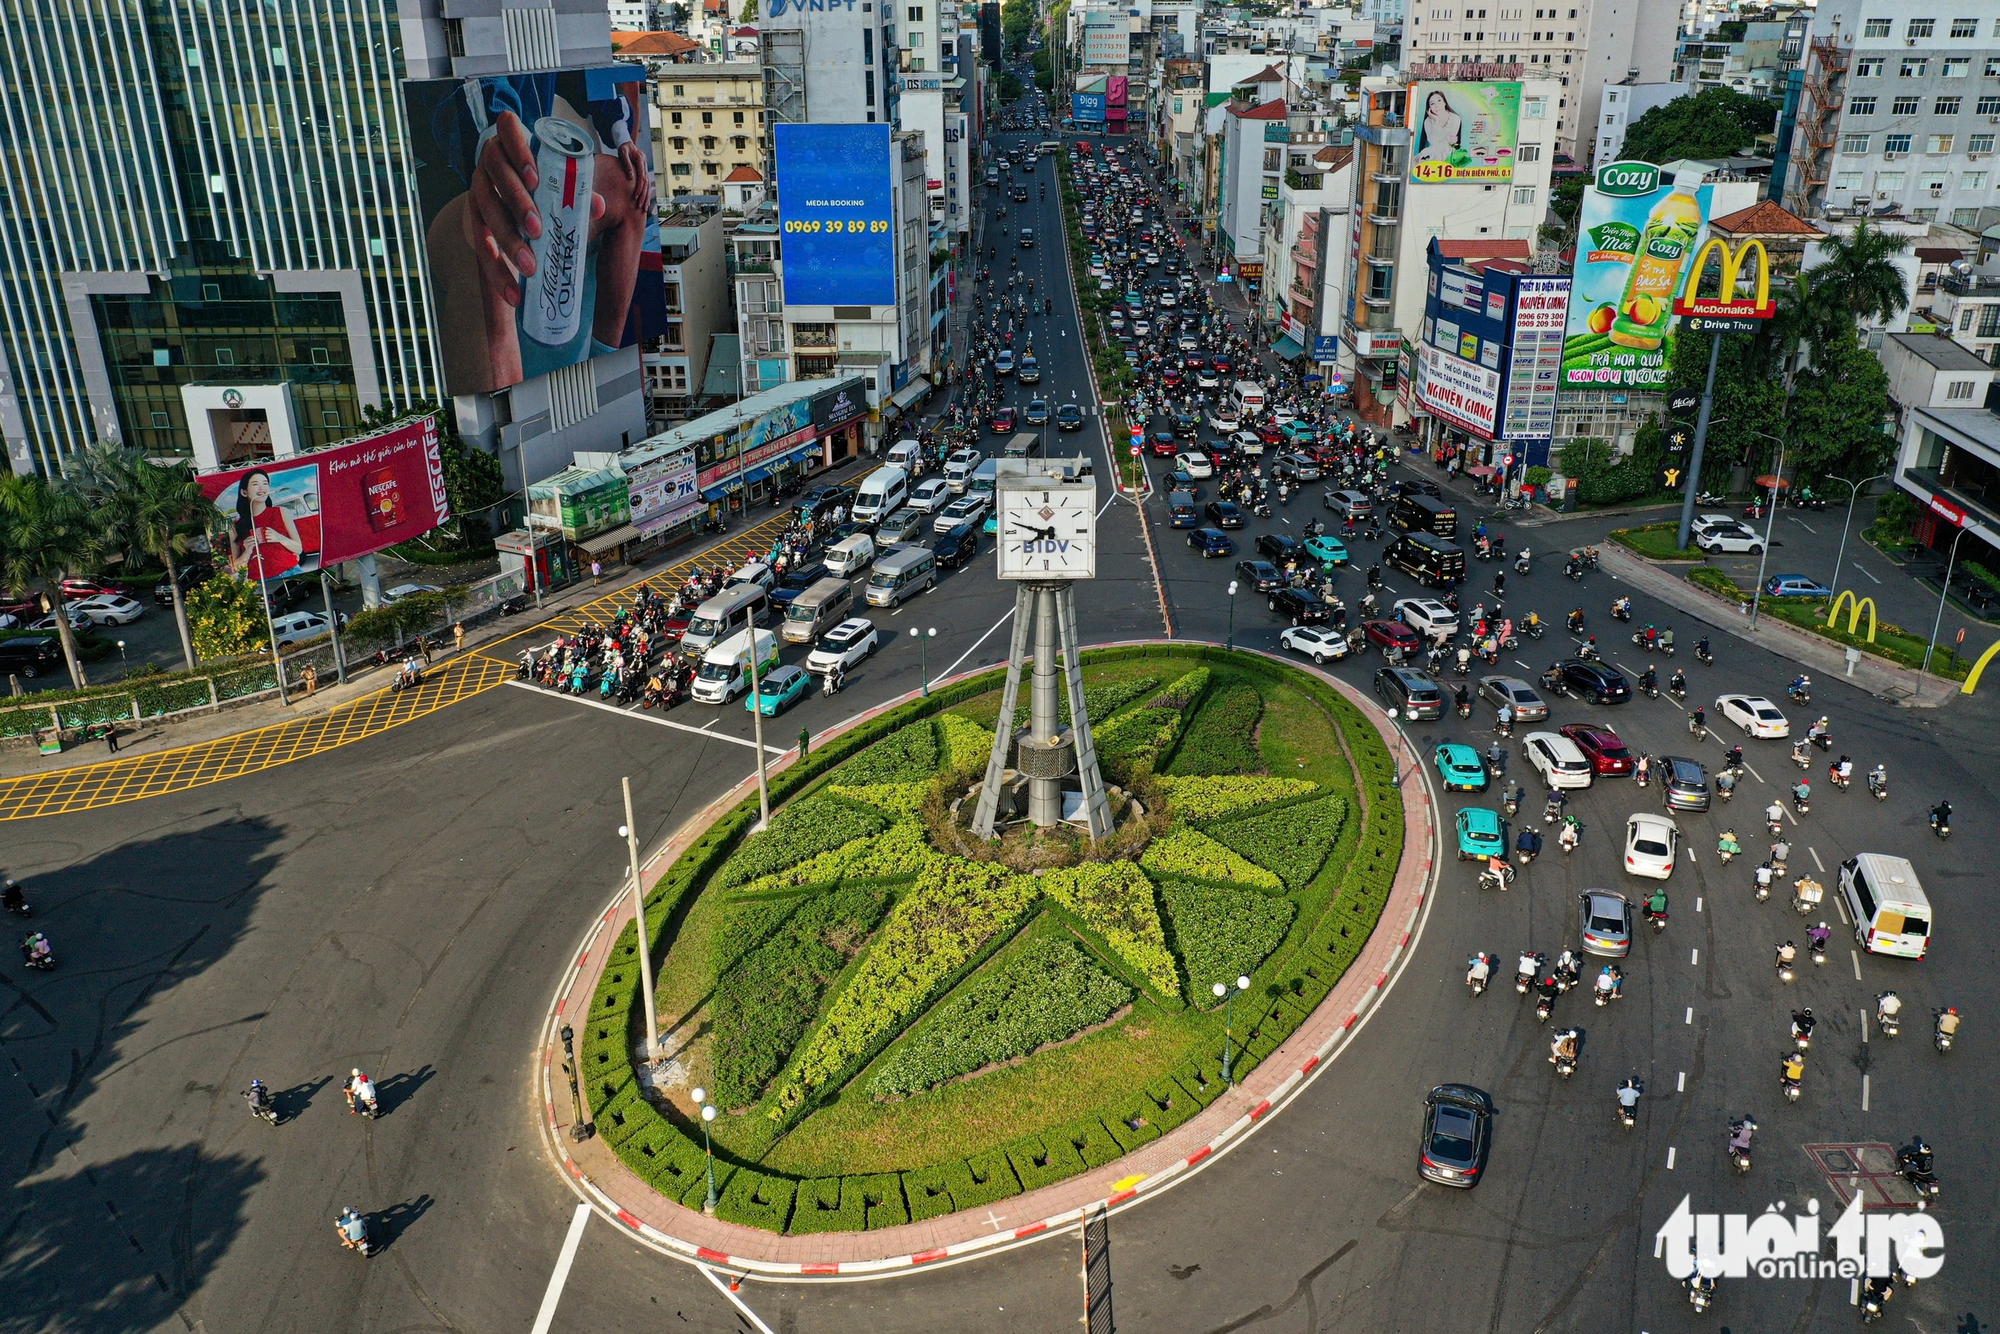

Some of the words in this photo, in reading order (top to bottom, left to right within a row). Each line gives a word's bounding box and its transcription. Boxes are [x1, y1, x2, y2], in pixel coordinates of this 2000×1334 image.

[793, 0, 857, 12] VNPT
[1415, 164, 1453, 178] 14-16
[1602, 168, 1653, 191] Cozy
[805, 199, 829, 207] MEDIA
[830, 199, 865, 207] BOOKING
[784, 220, 821, 233] 0969
[825, 220, 843, 233] 39
[847, 220, 866, 233] 89
[870, 220, 888, 233] 89
[1599, 235, 1634, 251] Mới
[1649, 240, 1680, 258] Cozy
[1442, 281, 1464, 294] Panasonic
[1547, 296, 1566, 310] GIANG
[1692, 304, 1755, 315] McDonald's
[1703, 320, 1731, 329] Drive
[1733, 320, 1754, 330] Thru
[1462, 341, 1475, 349] MPE
[1590, 350, 1610, 367] TRÀ
[1613, 353, 1636, 366] HOA
[1640, 349, 1664, 367] QUẢ
[1537, 371, 1554, 380] LS
[1568, 369, 1593, 382] NGON
[1464, 397, 1493, 422] GIANG
[678, 480, 695, 498] 7K
[1023, 540, 1069, 553] BIDV
